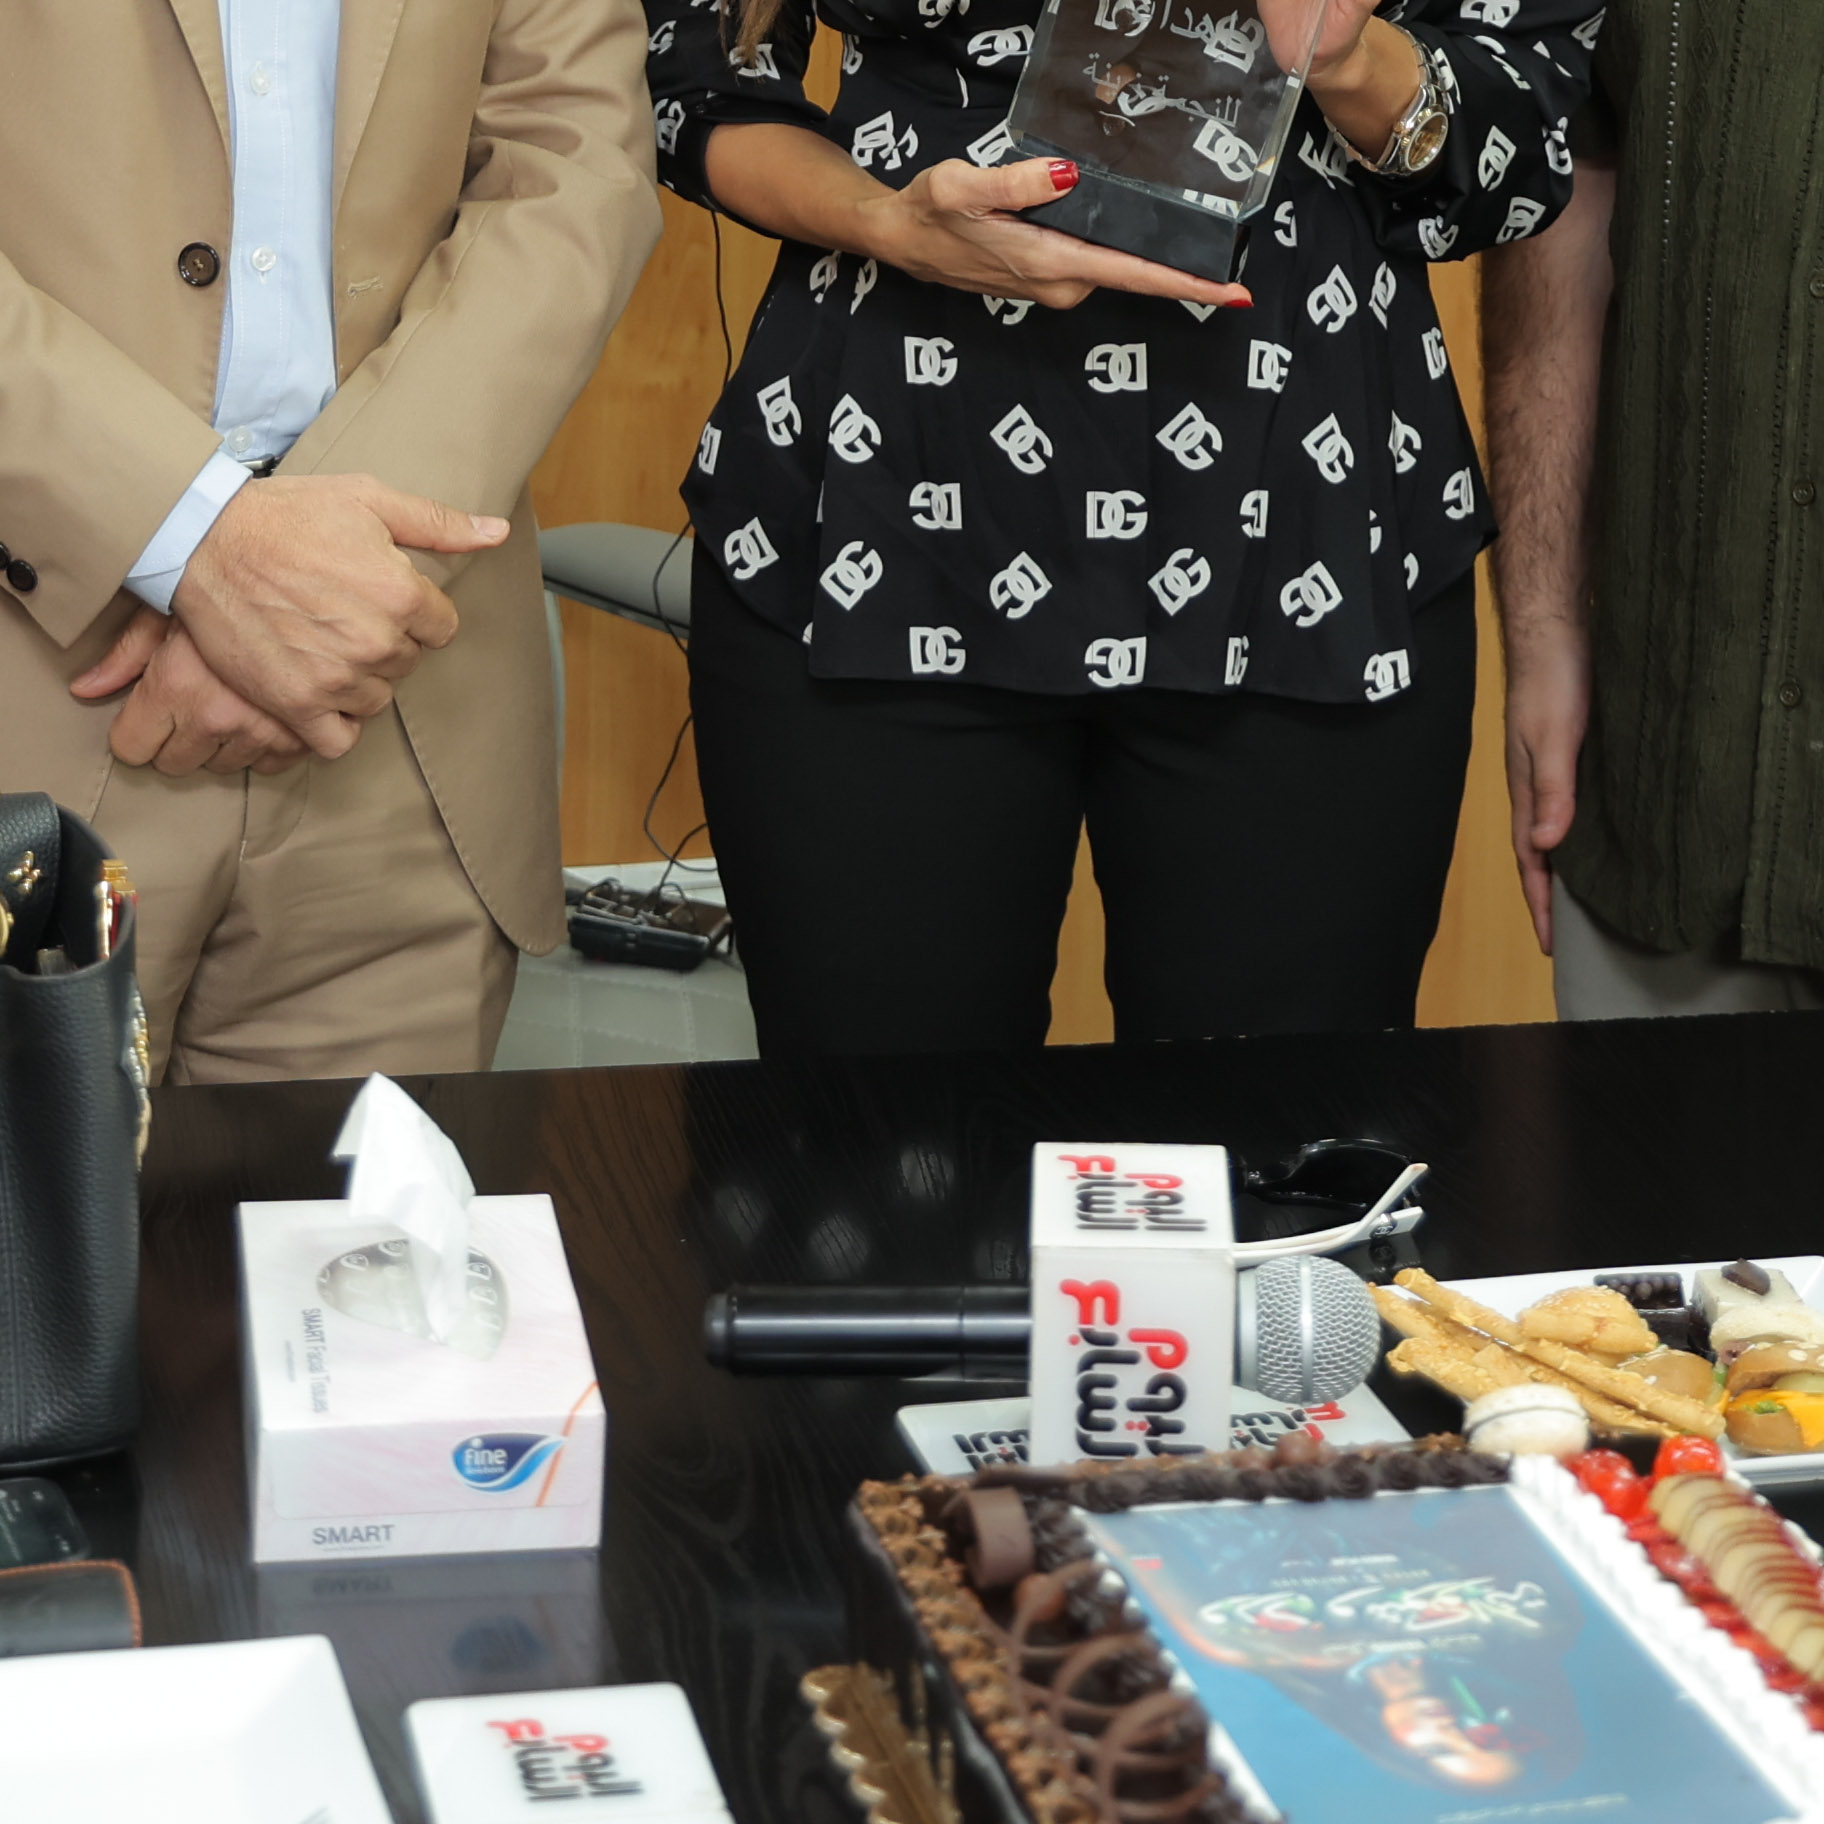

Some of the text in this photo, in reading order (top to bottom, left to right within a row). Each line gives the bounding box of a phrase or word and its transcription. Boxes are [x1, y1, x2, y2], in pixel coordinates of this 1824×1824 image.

[904, 336, 957, 386] DG
[1085, 343, 1147, 393] DG
[990, 404, 1053, 474] DG
[1156, 402, 1222, 470] DG
[1086, 490, 1147, 539] DG
[820, 541, 883, 611] DG
[990, 551, 1052, 619] DG
[1148, 548, 1211, 616] DG
[1280, 561, 1343, 627] DG
[909, 627, 965, 674] DG
[1085, 637, 1146, 688] DG
[1058, 1153, 1139, 1231] السابع
[1125, 1172, 1207, 1231] اليوم
[302, 1308, 325, 1343] SMART
[1126, 1327, 1207, 1457] ليوم
[464, 1437, 507, 1465] fine
[312, 1523, 395, 1546] SMART
